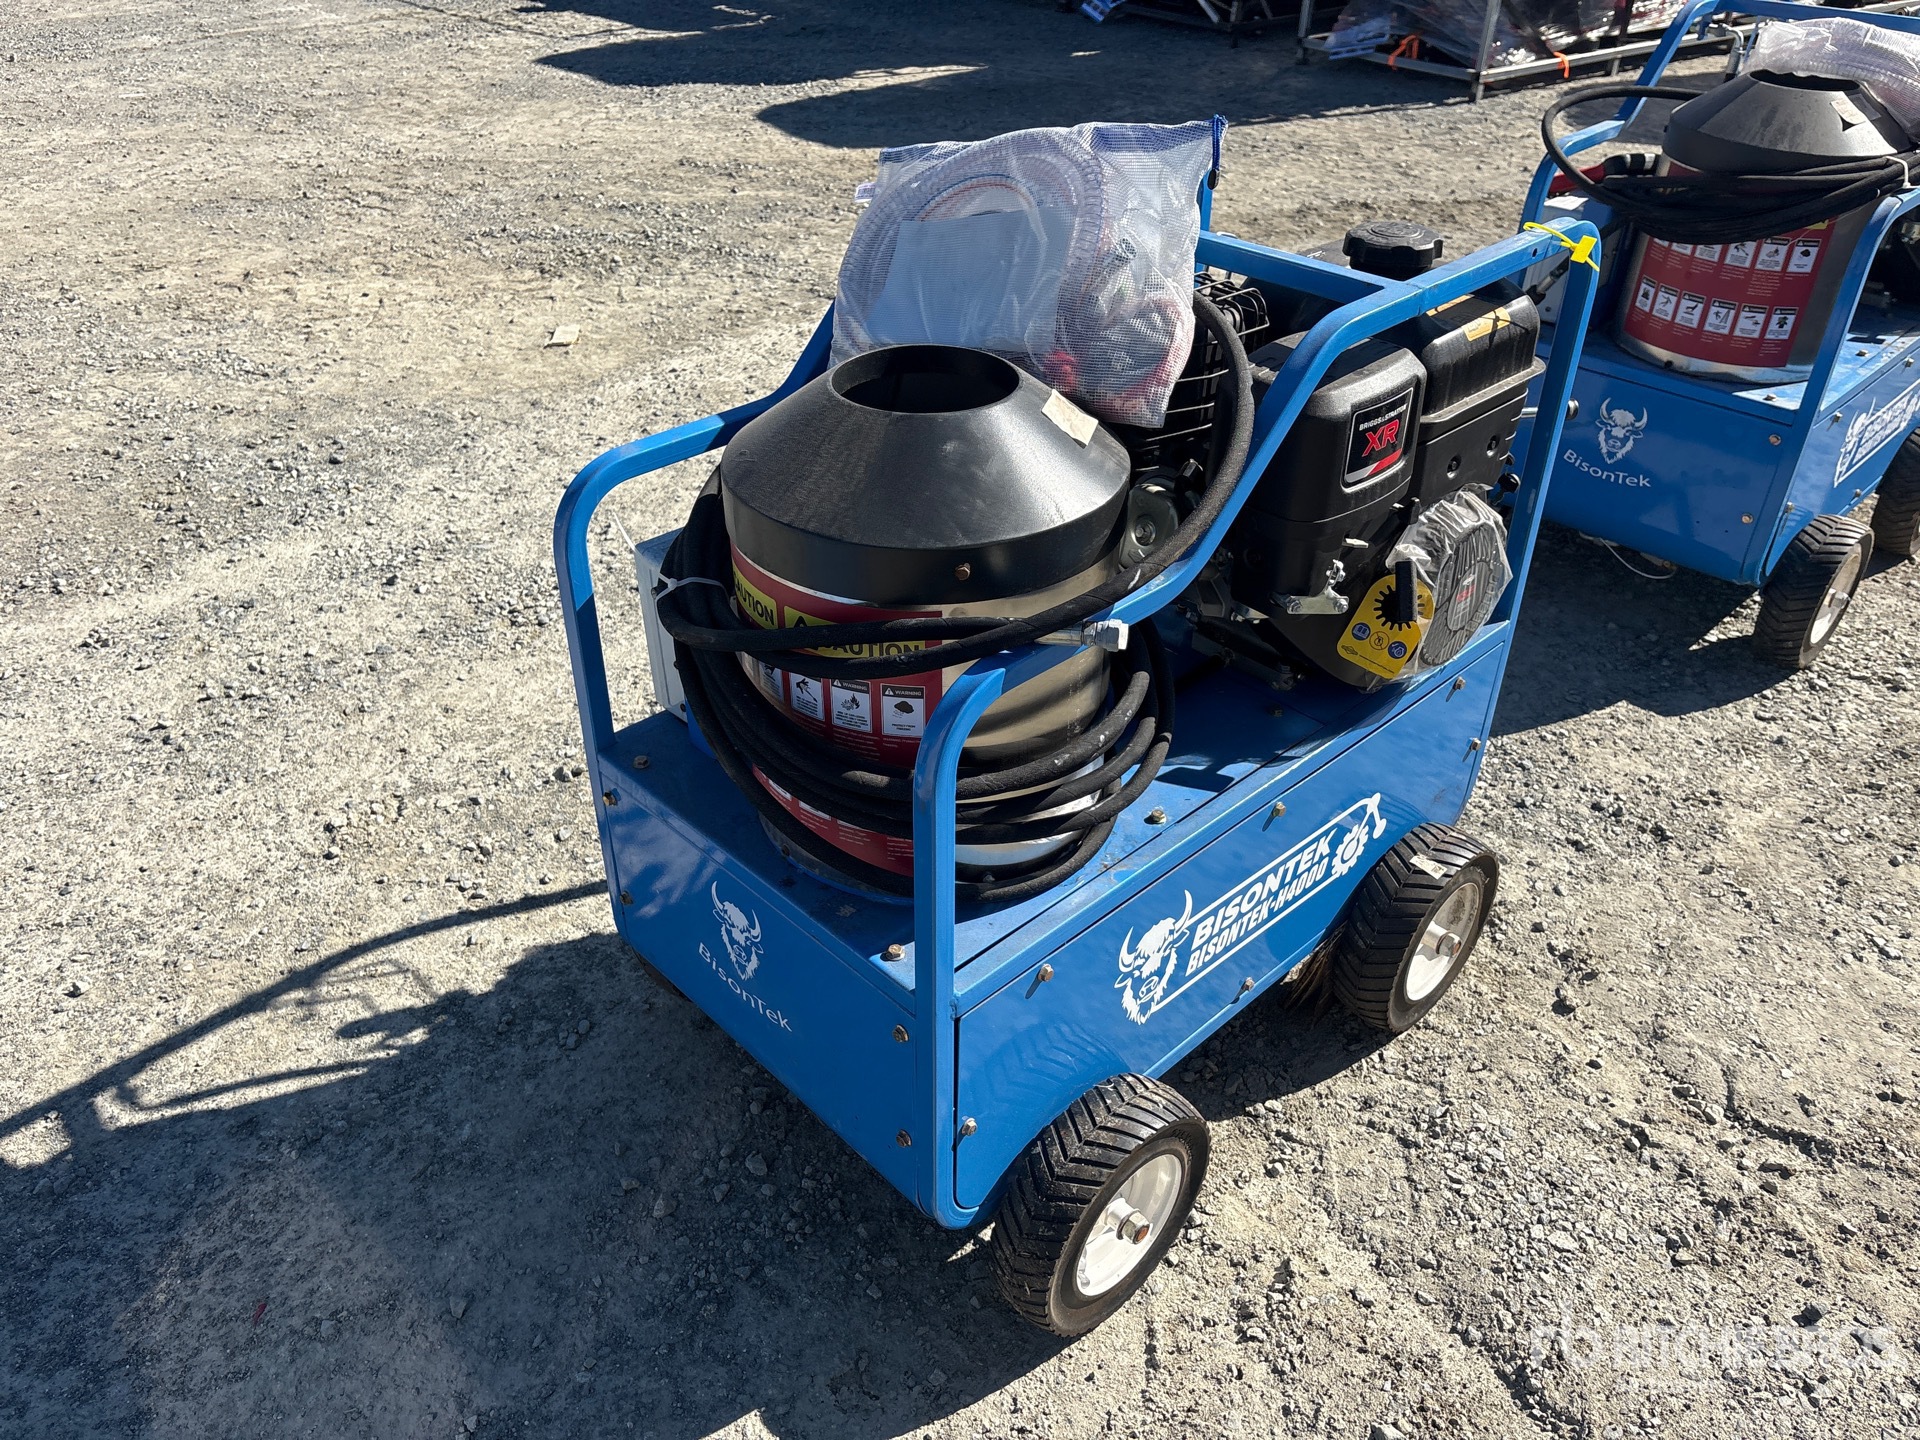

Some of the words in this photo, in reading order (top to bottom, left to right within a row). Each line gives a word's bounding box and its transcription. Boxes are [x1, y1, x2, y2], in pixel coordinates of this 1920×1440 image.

[1362, 419, 1399, 457] XR
[1563, 449, 1651, 488] BisonTek
[843, 682, 868, 691] WARNING
[1185, 856, 1329, 977] BISONTEK-H4000
[1191, 828, 1338, 950] BISONTEK
[699, 942, 792, 1032] BisonTek
